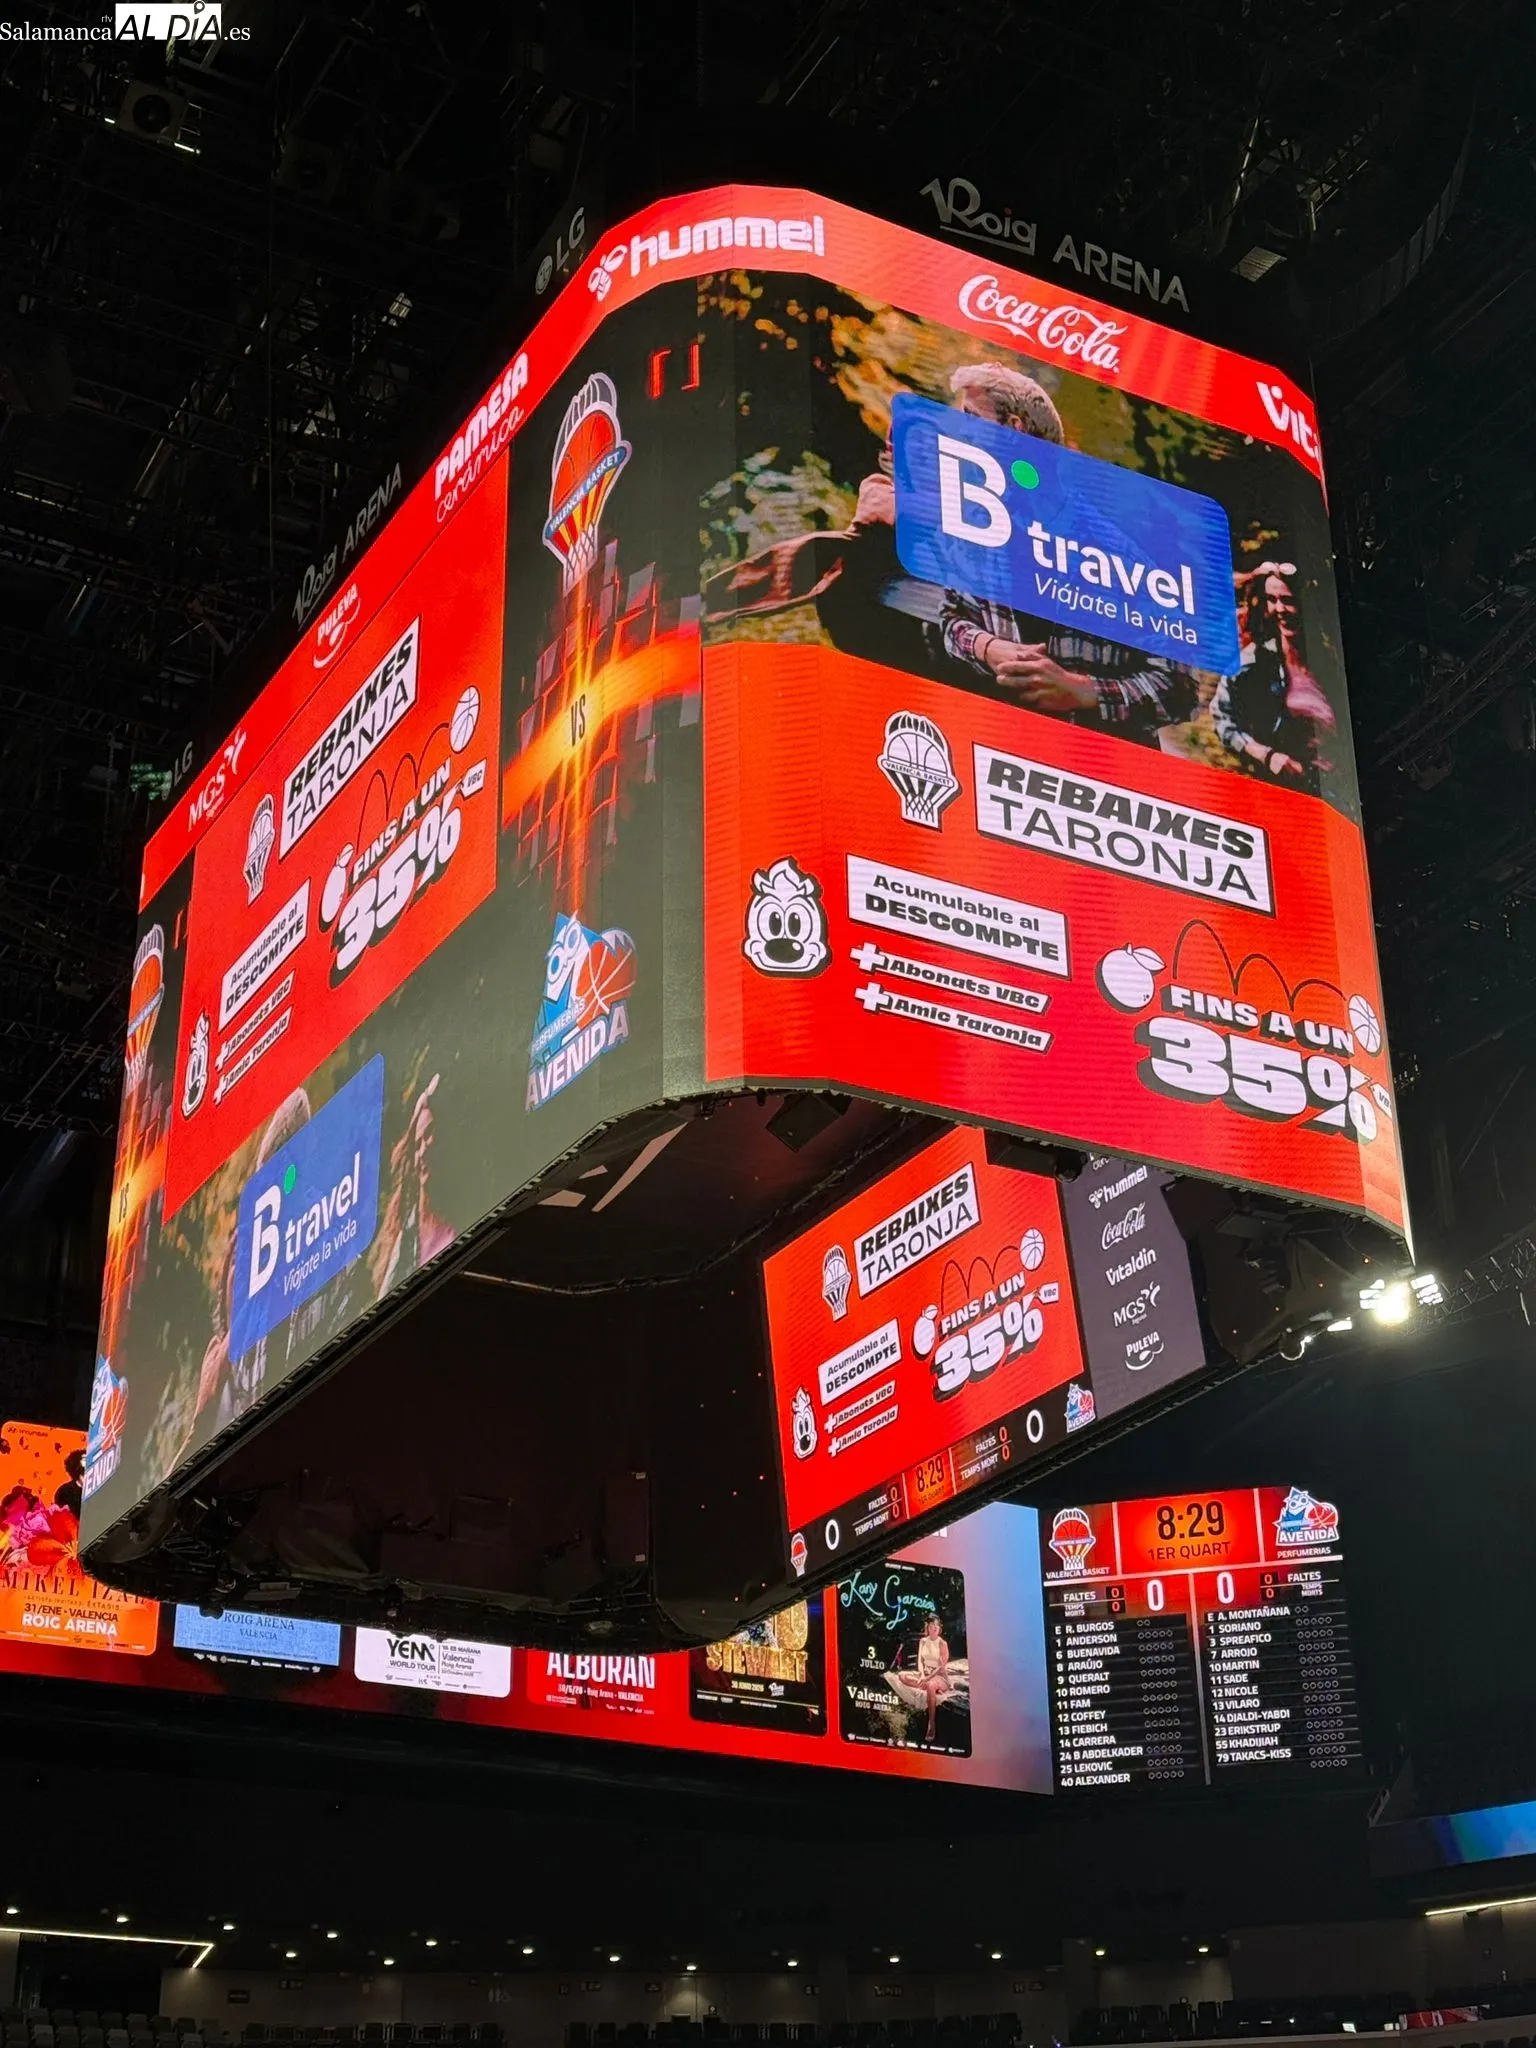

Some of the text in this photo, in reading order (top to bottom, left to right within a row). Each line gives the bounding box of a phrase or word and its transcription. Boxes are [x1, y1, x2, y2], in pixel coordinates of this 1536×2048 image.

[556, 206, 586, 272] LG
[630, 215, 825, 278] hummel
[1052, 234, 1190, 313] ARENA
[958, 274, 1129, 373] Coca-Cola
[434, 352, 528, 500] PAMESA
[937, 433, 1012, 548] B
[342, 462, 401, 564] ARENA
[1027, 520, 1195, 616] travel
[316, 582, 359, 647] PULEVA
[1034, 573, 1198, 645] Viájate la vida
[287, 632, 414, 809] REBAIXES
[571, 693, 586, 747] VS
[174, 740, 193, 788] LG
[287, 677, 409, 840] TARONJA
[886, 761, 950, 786] VALENCIA BASKET
[187, 762, 226, 832] MGS
[987, 757, 1255, 860] REBAIXES
[352, 757, 451, 884] FINS A UN
[989, 794, 1258, 901] TARONJA
[336, 784, 461, 971] 35%
[872, 874, 1040, 932] Acumulable al
[865, 893, 1059, 961] DESCOMPTE
[230, 902, 298, 988] Acumulable al
[225, 914, 304, 1014] DESCOMPTE
[890, 958, 1040, 1008] Abonats VBC
[894, 998, 1042, 1046] Amic Taronja
[1169, 984, 1355, 1056] FINS A UN
[525, 1005, 629, 1111] AVENIDA
[1149, 1016, 1377, 1141] 35%
[1103, 1165, 1148, 1203] hummel
[285, 1151, 361, 1264] travel
[860, 1172, 969, 1262] REBAIXES
[322, 1219, 357, 1263] la vida
[1101, 1201, 1146, 1250] Coca-Cola
[248, 1185, 282, 1299] B
[862, 1202, 973, 1286] TARONJA
[1105, 1248, 1157, 1287] Vitaldin
[942, 1271, 1025, 1335] FINS A UN
[1113, 1297, 1146, 1327] MGS
[827, 1332, 889, 1377] Acumulable al
[934, 1292, 1043, 1392] 35%
[1125, 1331, 1160, 1358] PULEVA
[825, 1342, 897, 1394] DESCOMPTE
[975, 1426, 1007, 1454] FALTES 0
[1026, 1409, 1044, 1443] 0
[915, 1455, 945, 1493] 8:29
[960, 1445, 1010, 1480] TEMPS MORT 0
[1156, 1501, 1225, 1540] 8:29
[1279, 1527, 1335, 1543] AVENIDA
[1147, 1541, 1231, 1560] 1ER QUART
[1277, 1546, 1331, 1559] PERFUMERIAS
[1, 1569, 80, 1596] MIKEL
[1046, 1566, 1110, 1580] VALENCIA BASKET
[1217, 1572, 1235, 1604] 0
[1264, 1571, 1322, 1585] 0 FALTES
[837, 1571, 883, 1617] Kany
[1063, 1588, 1119, 1602] FALTES 0
[1111, 1601, 1120, 1612] 0
[1147, 1579, 1164, 1611] 0
[1265, 1588, 1274, 1598] 0
[22, 1613, 118, 1636] ROIG ARENA
[24, 1603, 118, 1622] 31/ENE VALENCIA
[224, 1611, 295, 1631] ROIG ARENA
[1055, 1621, 1115, 1635] E R. BURGOS
[1207, 1606, 1291, 1622] E A. MONTAÑANA
[1208, 1621, 1261, 1634] 1 SORIANO
[239, 1628, 278, 1641] VALENCIA
[1056, 1634, 1118, 1647] 1 ANDERSON
[1209, 1633, 1272, 1647] 3 SPREAFICO
[389, 1659, 436, 1672] WORLD TOUR
[441, 1652, 475, 1664] Valencia
[859, 1658, 885, 1670] JULIO
[867, 1646, 876, 1660] 3
[1056, 1646, 1121, 1660] 6 BUENAVIDA
[1056, 1663, 1064, 1672] 8
[1209, 1660, 1260, 1672] 10 MARTIN
[1210, 1647, 1258, 1660] 7 ARROJO
[1056, 1685, 1111, 1697] 10 ROMERO
[1057, 1672, 1110, 1685] 9 QUERALT
[1210, 1673, 1249, 1685] 11 SADE
[1211, 1685, 1259, 1698] 12 NICOLE
[846, 1686, 899, 1705] Valencia
[1057, 1699, 1091, 1710] 11 FAM
[1212, 1698, 1260, 1711] 13 VILARO
[1058, 1710, 1106, 1723] 12 COFFEY
[1058, 1723, 1108, 1735] 13 FIEBICH
[1213, 1714, 1226, 1724] 14
[1214, 1723, 1281, 1737] 23 ERIKSTRUP
[1059, 1735, 1117, 1748] 14 CARRERA
[1059, 1746, 1144, 1761] 24 B ABDELKADER
[1215, 1740, 1228, 1750] 55
[1216, 1748, 1292, 1763] 79 TAKACS-KISS
[1060, 1761, 1113, 1774] 25 LEKOVIC
[1061, 1773, 1131, 1787] 40 ALEXANDER
